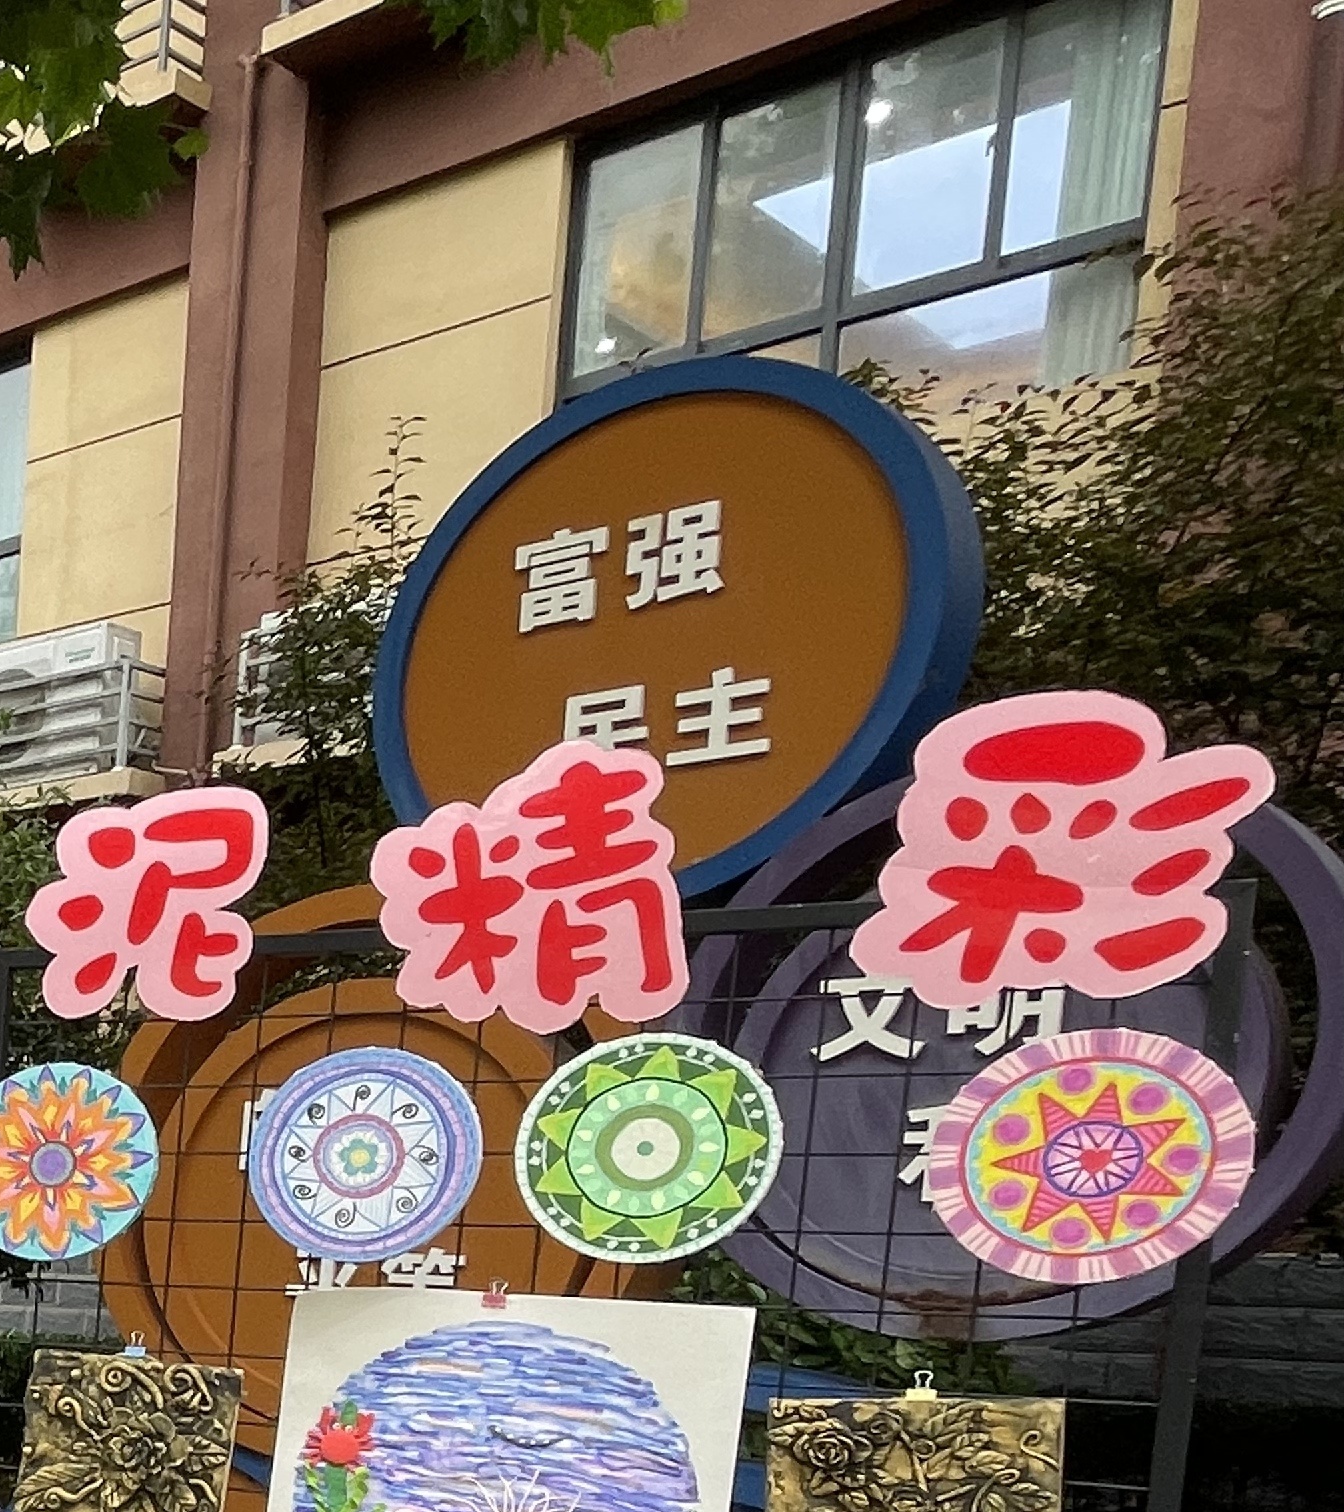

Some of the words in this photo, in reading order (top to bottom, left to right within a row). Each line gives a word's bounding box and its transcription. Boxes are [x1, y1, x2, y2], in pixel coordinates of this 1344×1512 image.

[515, 500, 725, 633] 富强
[564, 666, 772, 767] 民主
[810, 975, 1066, 1062] 文明
